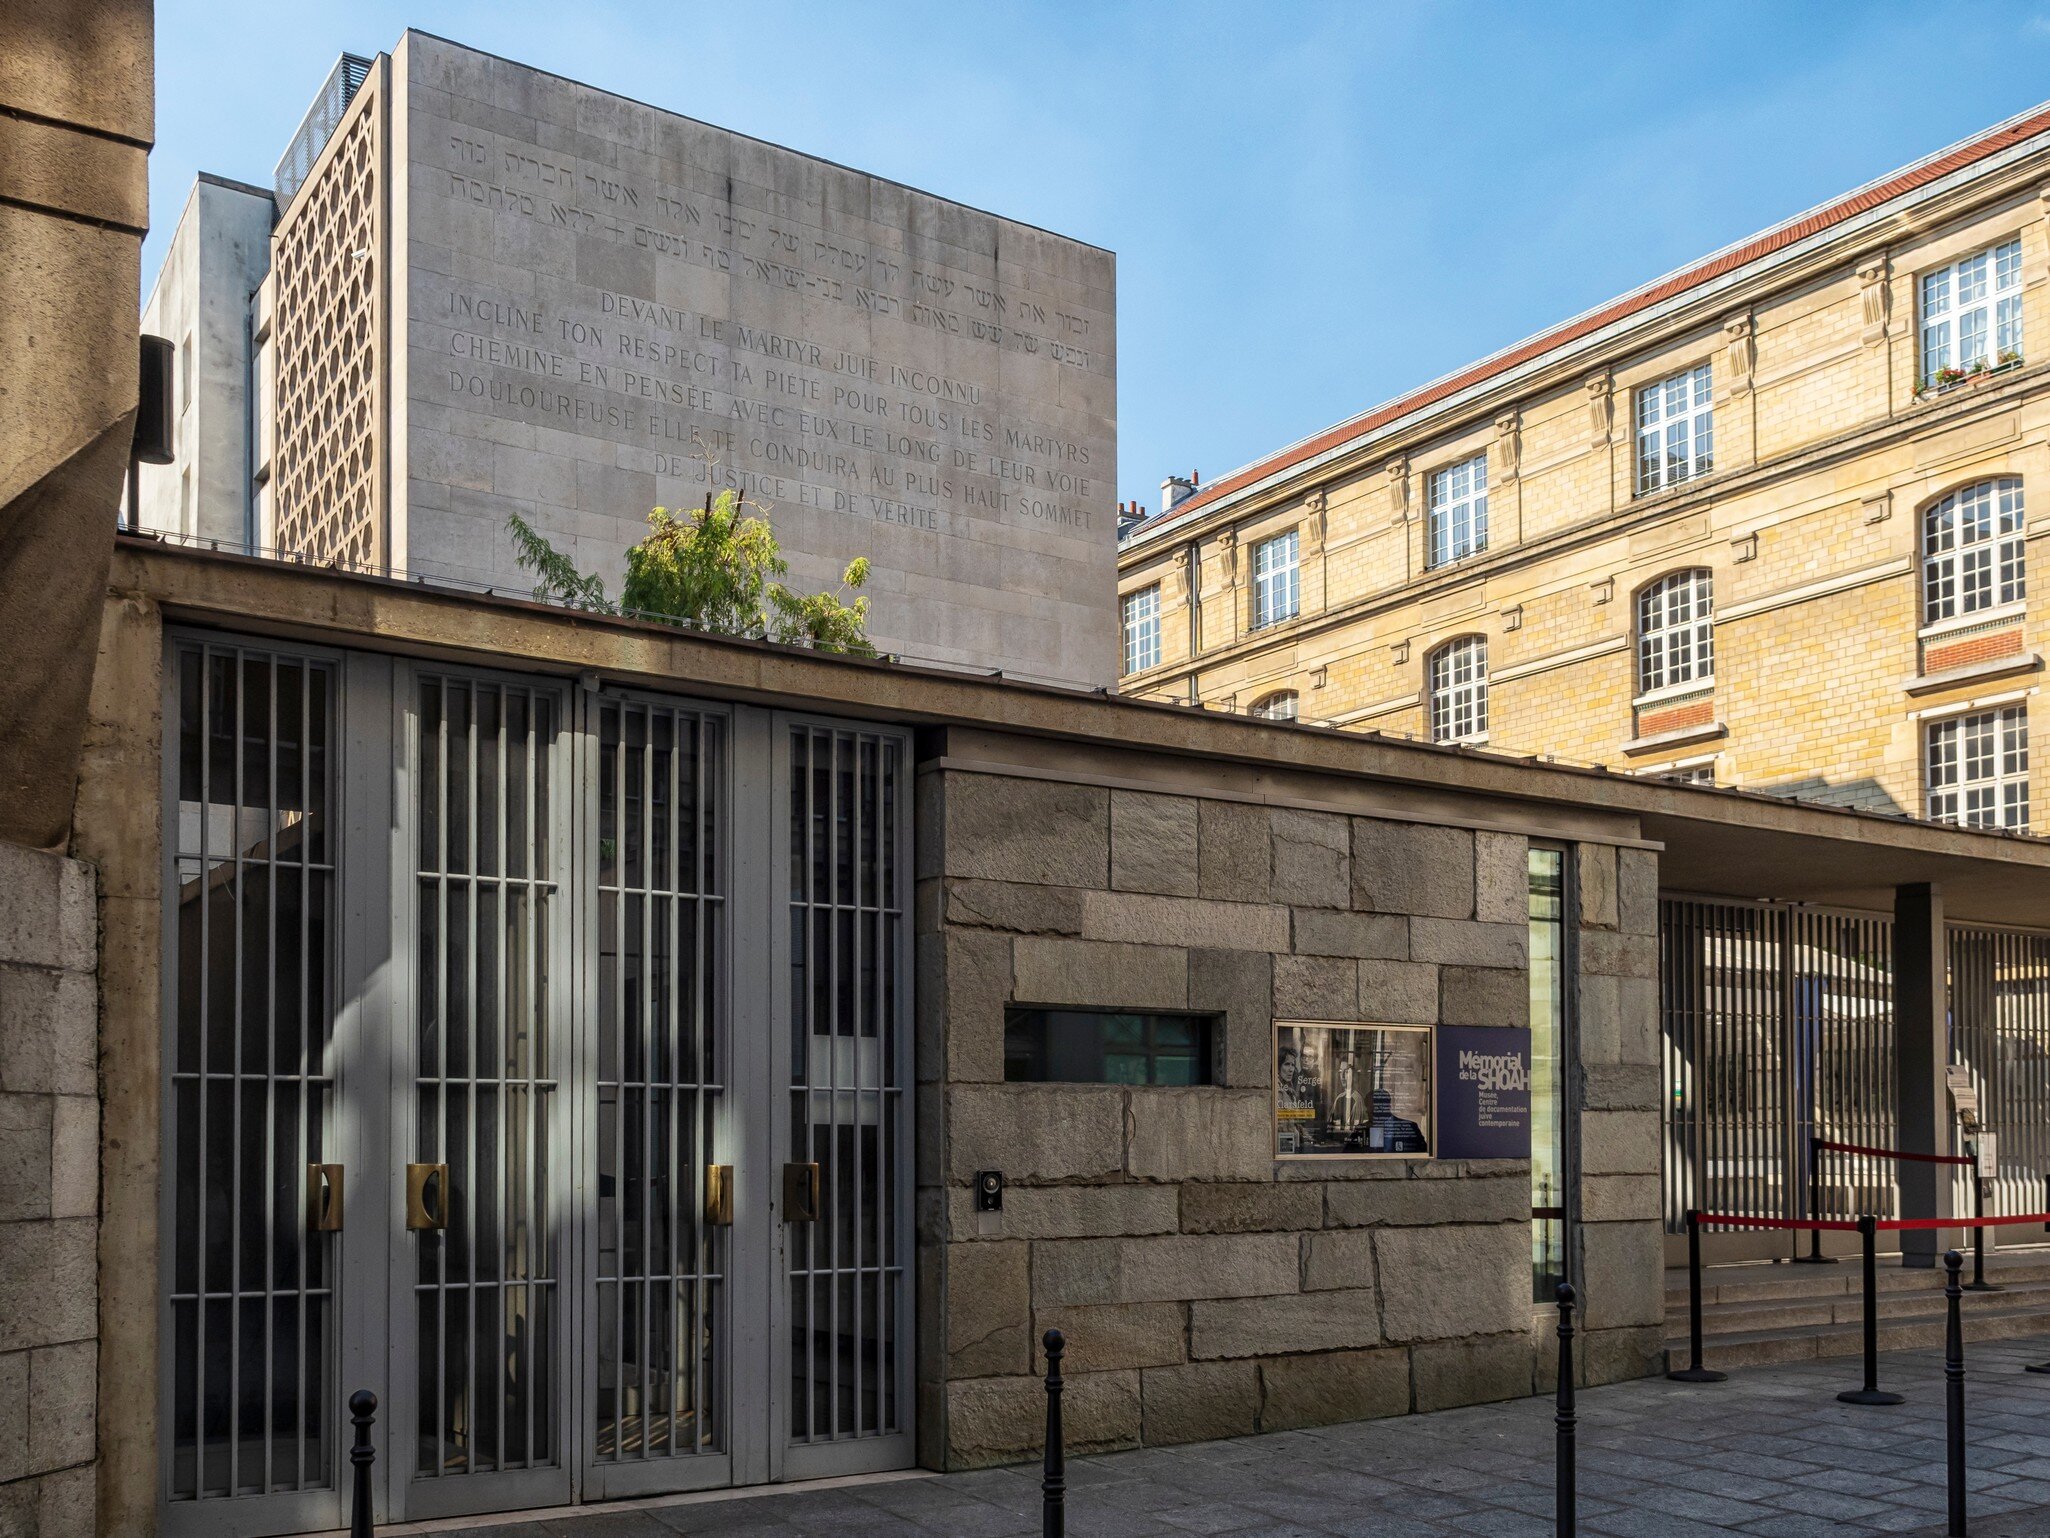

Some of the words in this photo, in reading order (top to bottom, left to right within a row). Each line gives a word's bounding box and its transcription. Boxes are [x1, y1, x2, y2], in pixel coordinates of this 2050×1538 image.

[451, 175, 534, 216] מלחמה
[585, 174, 638, 209] אשר
[551, 203, 594, 232] ללא
[656, 195, 699, 226] אלה
[715, 212, 756, 239] ימינו
[634, 226, 688, 259] ונשים
[768, 228, 799, 252] של
[703, 245, 731, 270] טף
[814, 241, 866, 273] עמלק
[876, 259, 899, 282] לך
[912, 270, 955, 298] עשה
[964, 285, 1006, 314] אשר
[1020, 302, 1045, 324] את
[912, 304, 960, 333] מאות
[971, 321, 1002, 343] שש
[1055, 312, 1089, 334] זכור
[601, 292, 686, 331] DEVANT
[699, 317, 723, 341] LE
[737, 327, 822, 366] MARTYR
[833, 352, 879, 379] JUIF
[890, 366, 980, 405] INCONNU
[1013, 332, 1039, 353] של
[1050, 342, 1089, 368] ונפש
[450, 292, 544, 334] INCLINE
[558, 318, 603, 348] TON
[619, 333, 719, 376] RESPECT
[731, 361, 753, 384] TA
[834, 386, 888, 417] POUR
[899, 402, 949, 431] TOUS
[961, 417, 994, 442] LES
[1005, 428, 1090, 465] MARTYRS
[451, 333, 564, 377] CHEMINE
[579, 361, 608, 386] EN
[728, 399, 785, 427] AVEC
[799, 413, 839, 440] EUX
[851, 425, 874, 448] LE
[887, 433, 941, 462] LONG
[953, 449, 978, 471] DE
[989, 457, 1036, 485] LEUR
[1046, 470, 1090, 497] VOIE
[450, 370, 635, 431] DOULOUREUSE
[649, 415, 700, 445] ELLE
[711, 428, 736, 452] TE
[750, 438, 860, 480] CONDUIRA
[869, 466, 894, 486] AU
[905, 472, 953, 499] PLUS
[963, 485, 1010, 512] HAUT
[1018, 497, 1091, 529] SOMMET
[655, 453, 682, 477] DE
[694, 463, 786, 499] JUSTICE
[799, 484, 822, 506] ET
[834, 491, 858, 514] DE
[1459, 1050, 1522, 1070] Mémorial
[1298, 1075, 1322, 1086] Serge
[1459, 1070, 1469, 1080] de
[1470, 1070, 1477, 1080] la
[1477, 1069, 1531, 1091] SHOAH
[1478, 1120, 1520, 1128] contemporaine
